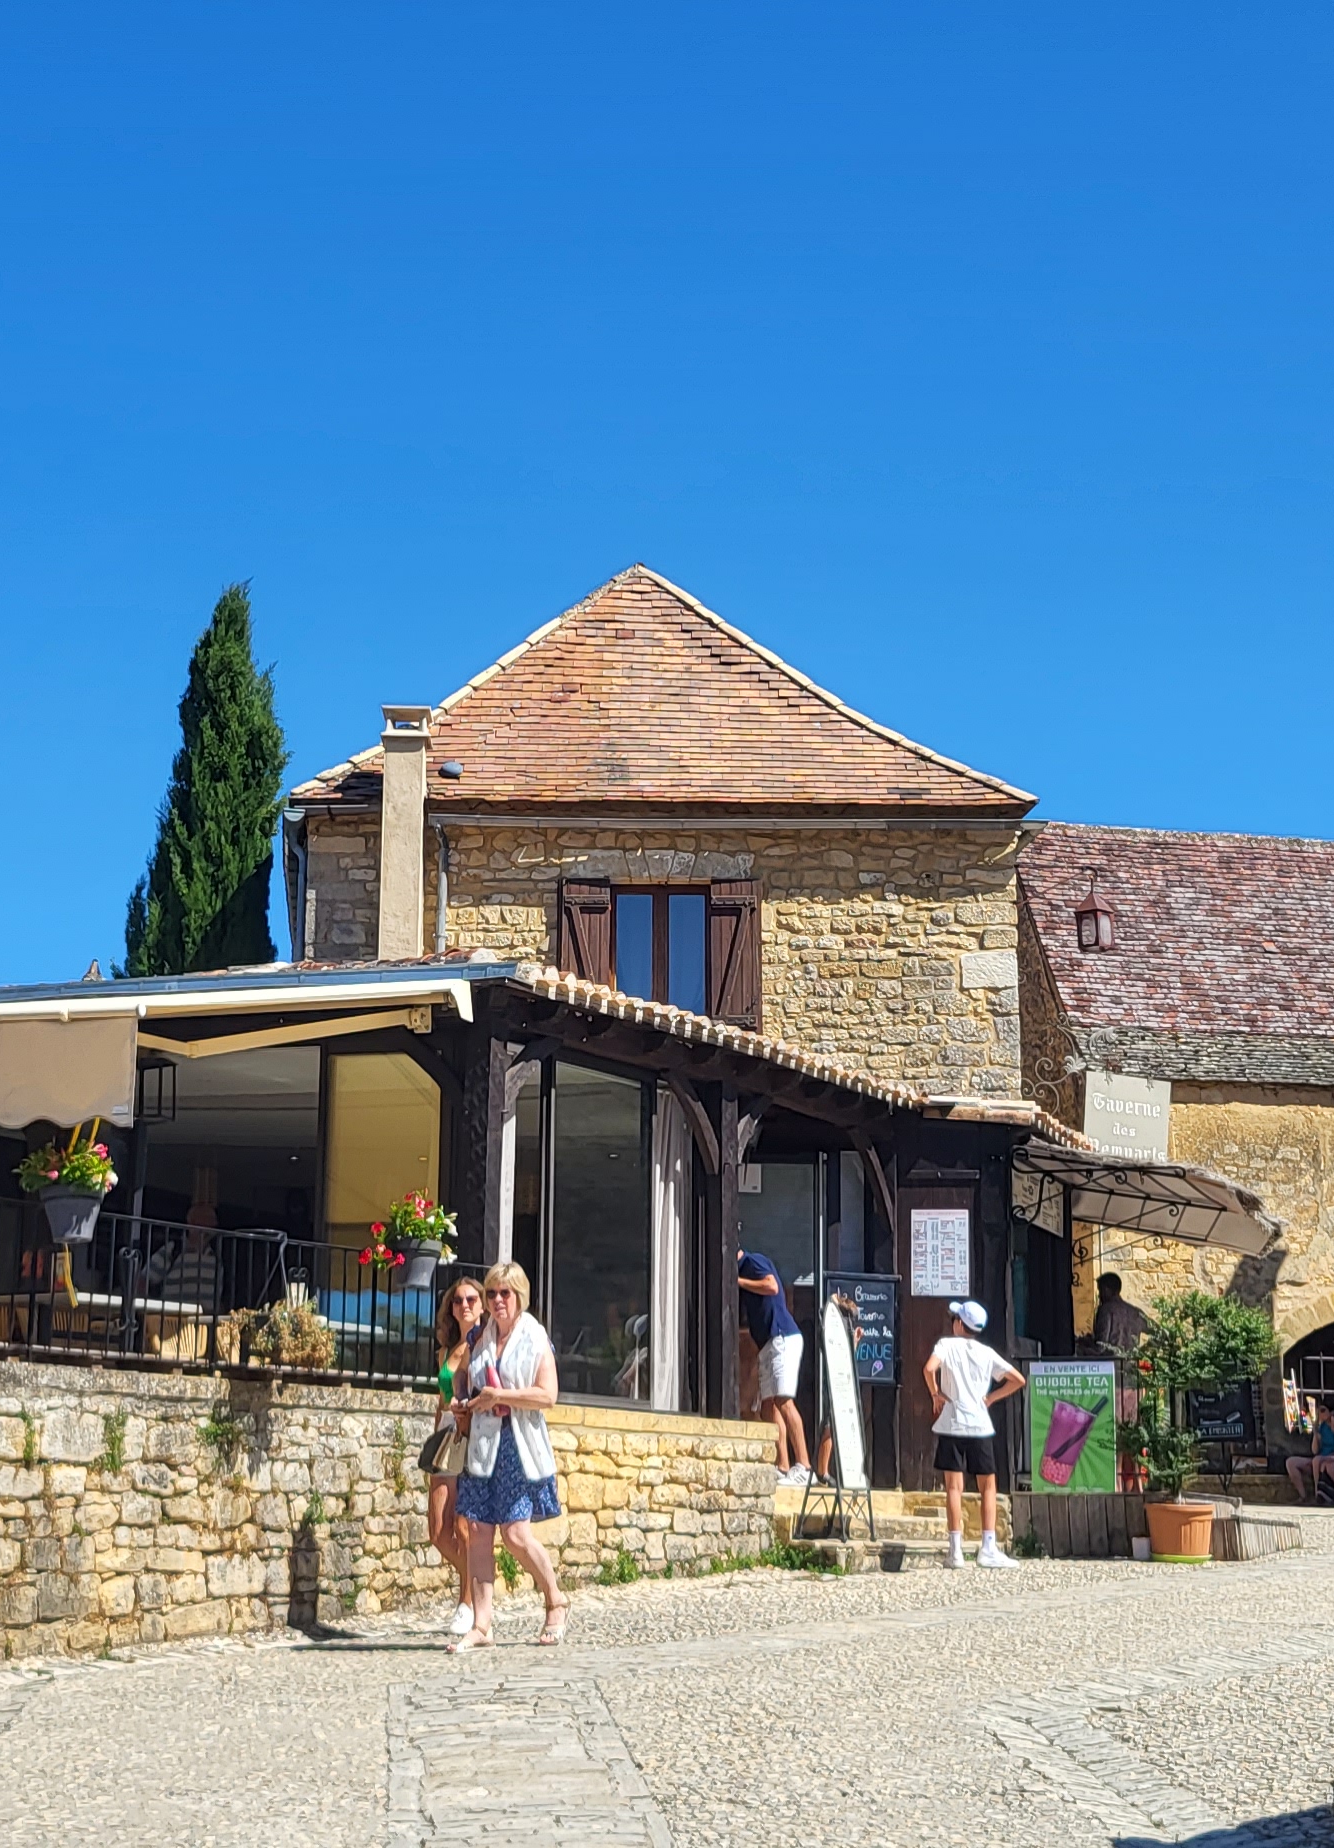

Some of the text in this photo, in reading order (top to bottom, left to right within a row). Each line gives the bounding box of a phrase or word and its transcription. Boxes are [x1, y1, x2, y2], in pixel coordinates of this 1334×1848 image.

[1092, 1092, 1161, 1118] Taverne
[1112, 1121, 1136, 1137] des
[1044, 1365, 1056, 1373] EN
[1057, 1365, 1086, 1373] VENTE
[1035, 1376, 1109, 1387] BUBBLE TEA
